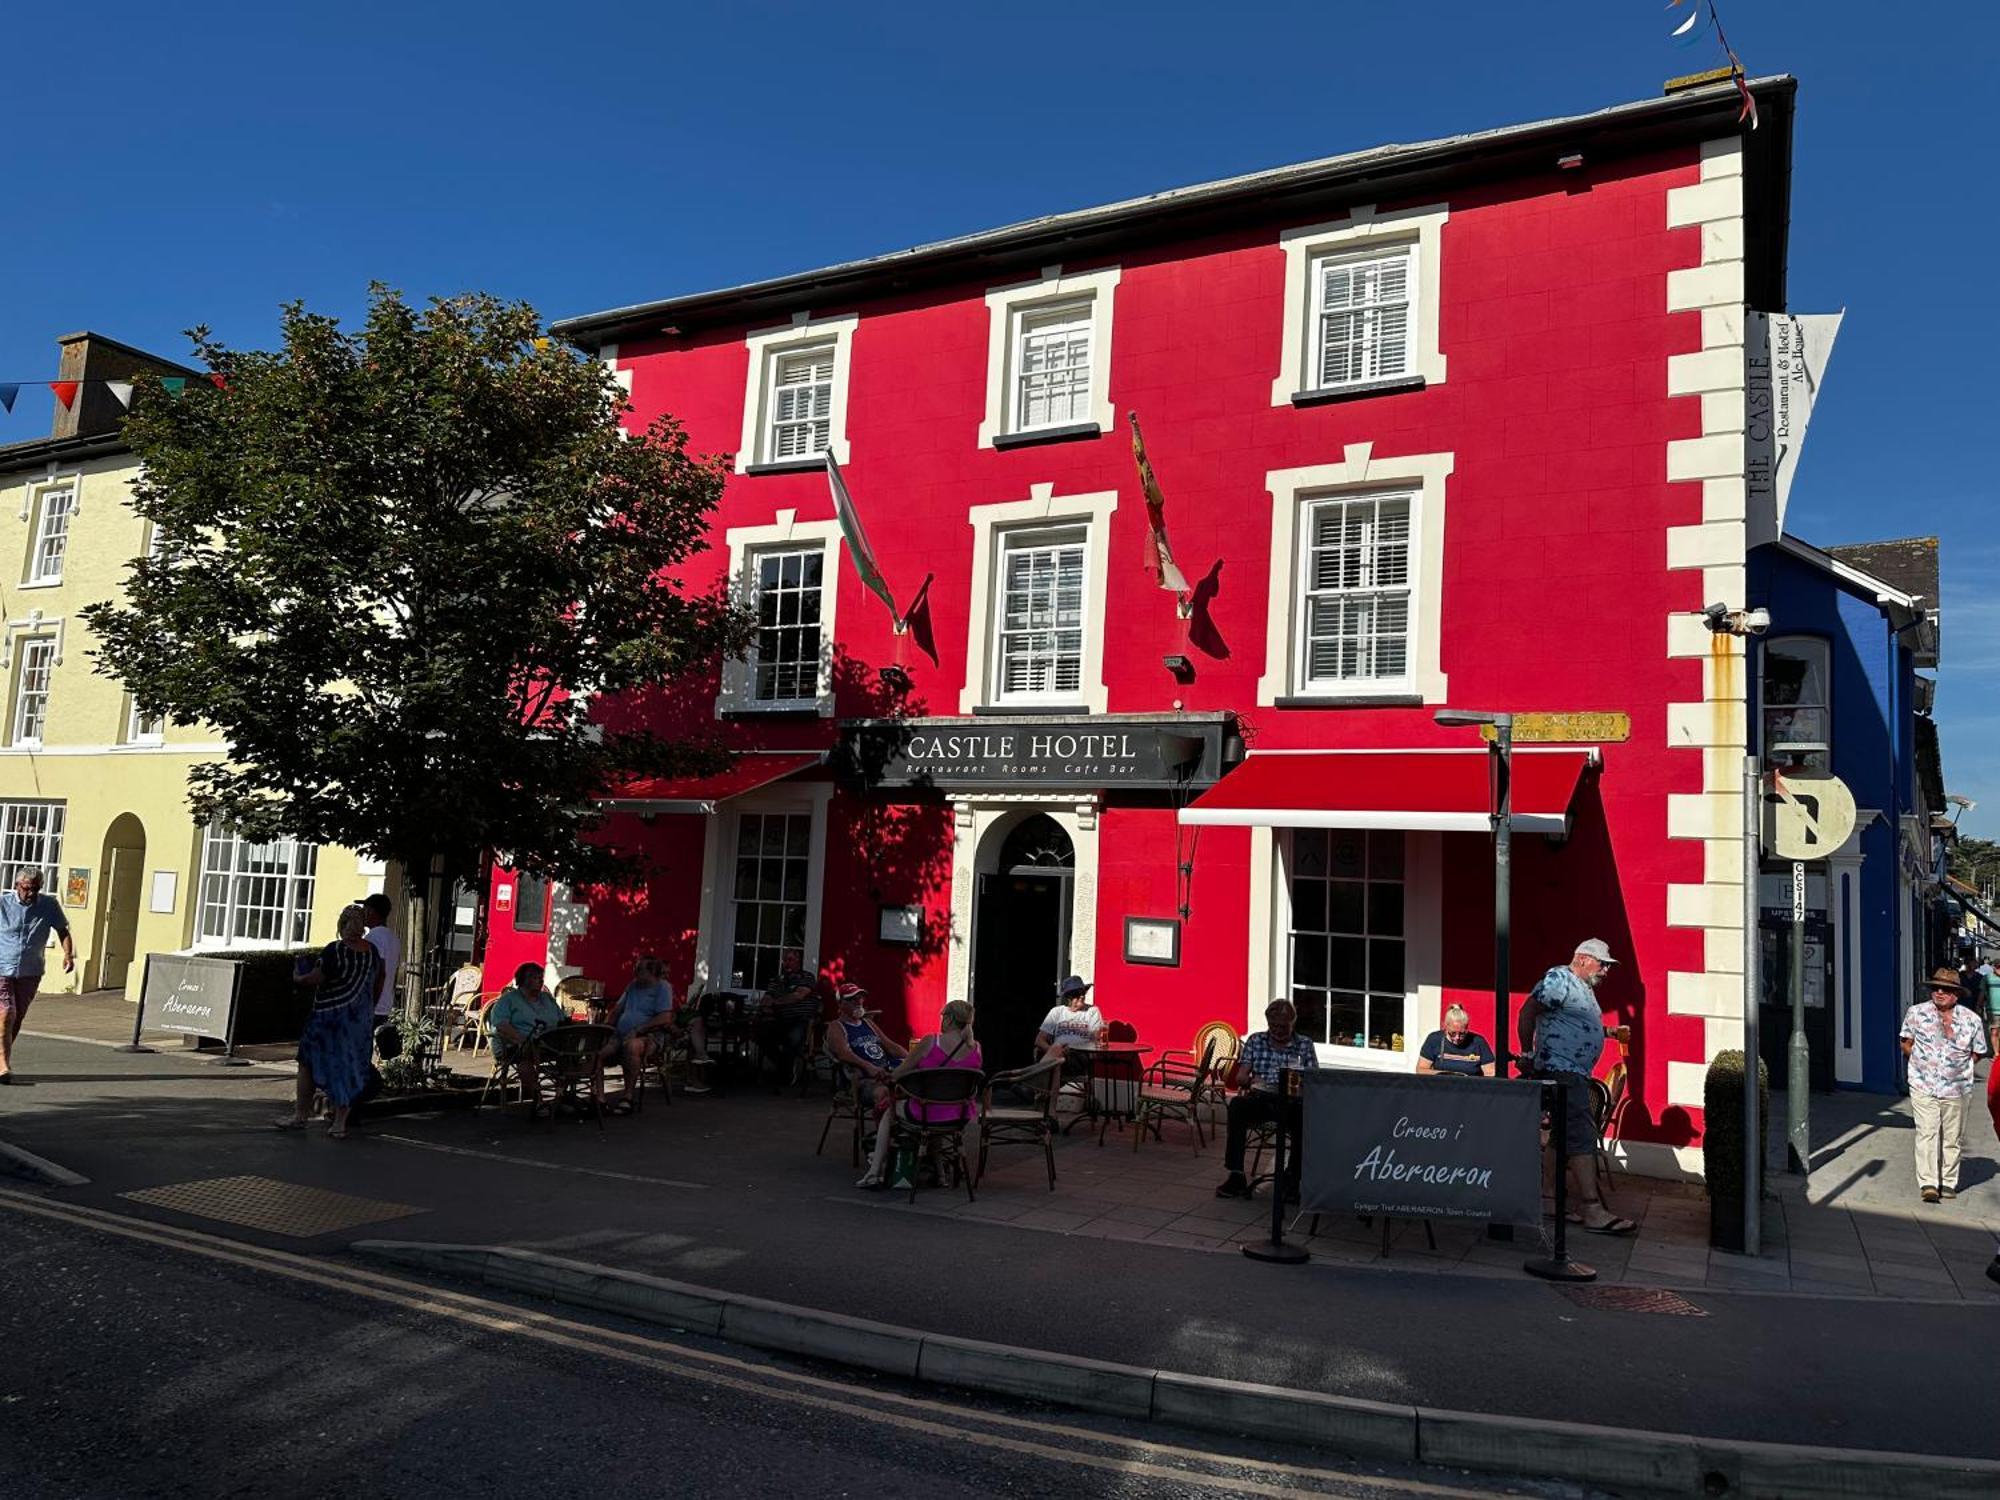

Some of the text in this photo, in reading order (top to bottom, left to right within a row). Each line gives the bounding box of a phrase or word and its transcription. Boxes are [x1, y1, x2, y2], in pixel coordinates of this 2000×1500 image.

[1776, 321, 1790, 438] Restaurant & Hotel
[1792, 361, 1804, 383] Ale
[1748, 356, 1771, 499] THE CASTLE
[907, 735, 1136, 759] CASTLE HOTEL
[905, 764, 986, 774] Restaurant
[1002, 764, 1047, 773] Rooms
[1109, 764, 1136, 773] Bar
[1392, 1116, 1464, 1140] Croeso i
[1354, 1145, 1492, 1189] Aberaeron
